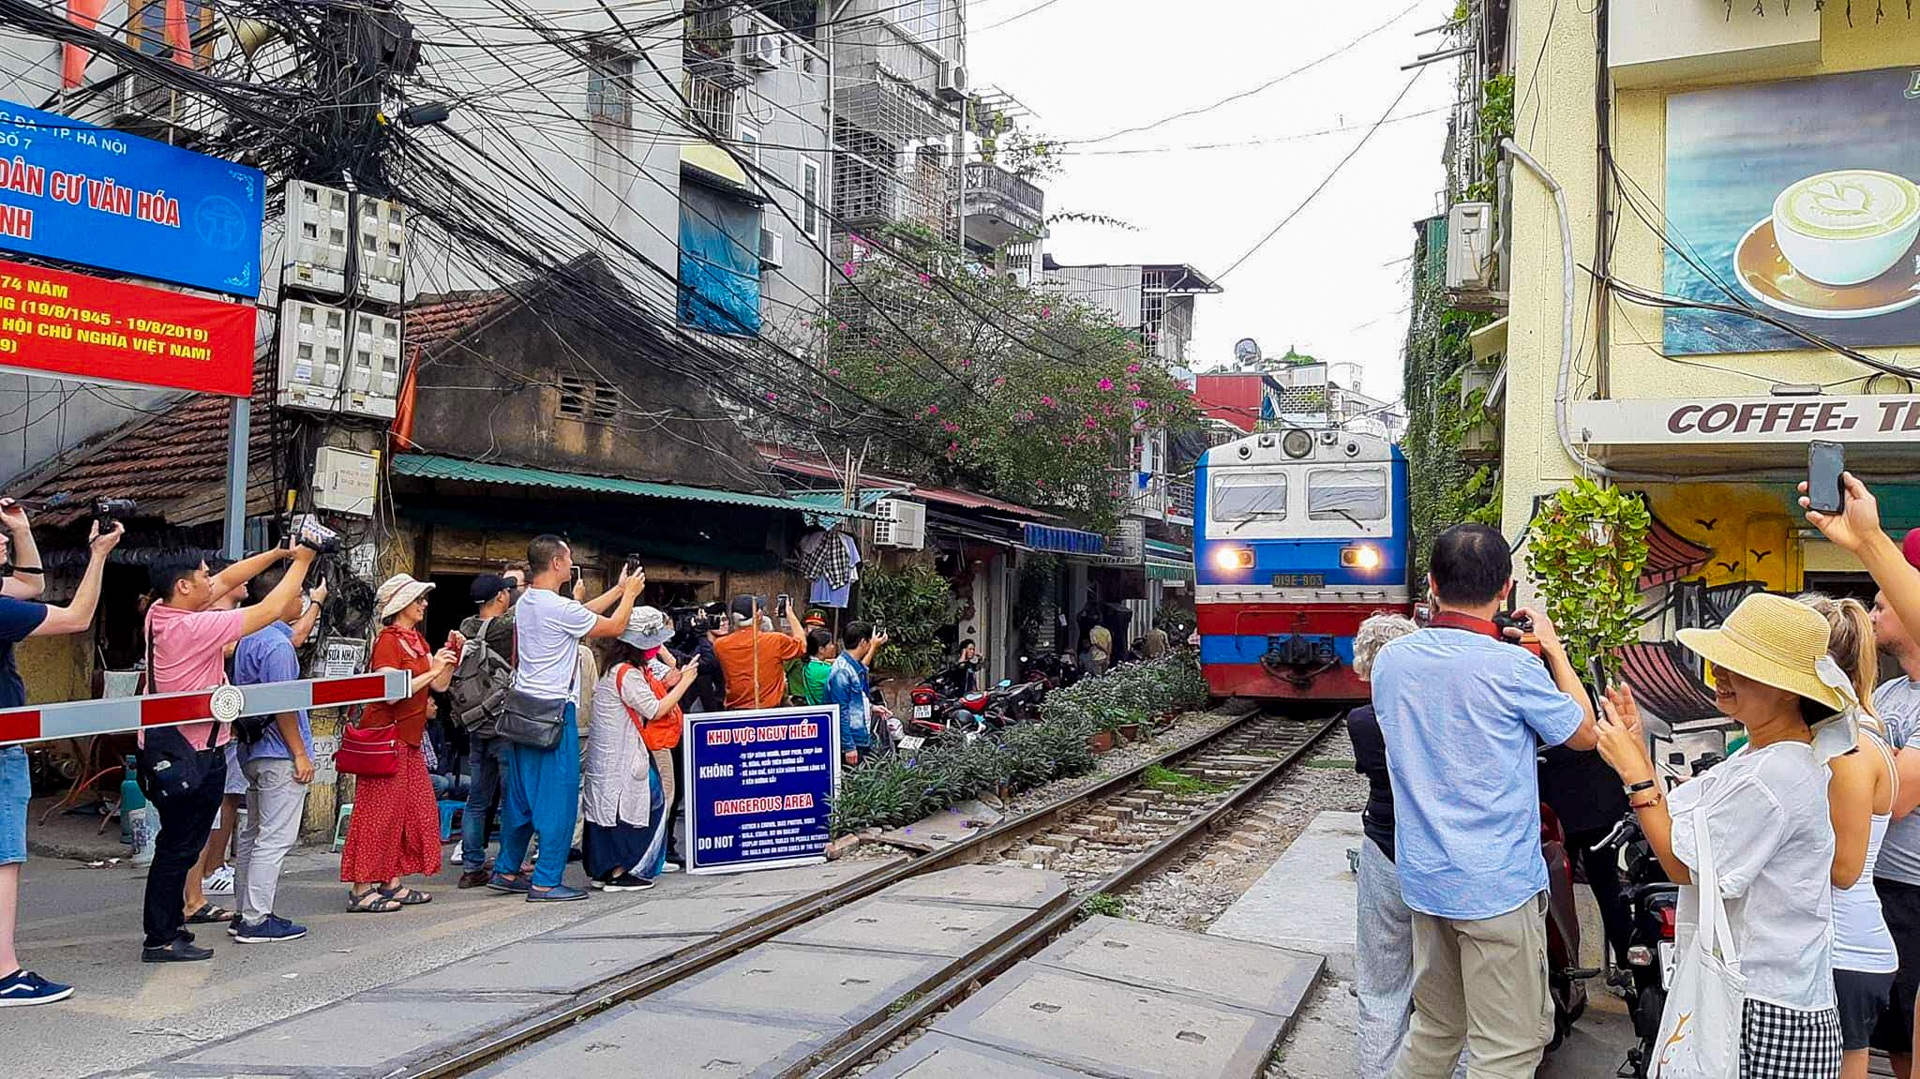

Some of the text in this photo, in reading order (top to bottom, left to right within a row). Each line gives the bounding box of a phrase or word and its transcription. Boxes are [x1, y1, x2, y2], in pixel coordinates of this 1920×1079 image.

[0, 131, 32, 150] SỐ 7
[77, 130, 97, 147] HÀ
[101, 138, 127, 156] NỘI
[0, 155, 180, 228] DÂN CƯ VĂN HÓA
[0, 274, 69, 299] 74 NĂM
[21, 299, 110, 326] (19/8/1945
[127, 317, 208, 343] 19/8/2019)
[2, 316, 211, 361] HỘI CHỦ NGHĨA VIỆT NAM!
[707, 719, 818, 745] KHU VỰC NGUY HIỂM
[699, 763, 734, 779] KHÔNG
[714, 793, 814, 816] DANGEROUS AREA
[698, 837, 712, 850] DO
[714, 835, 734, 849] NOT
